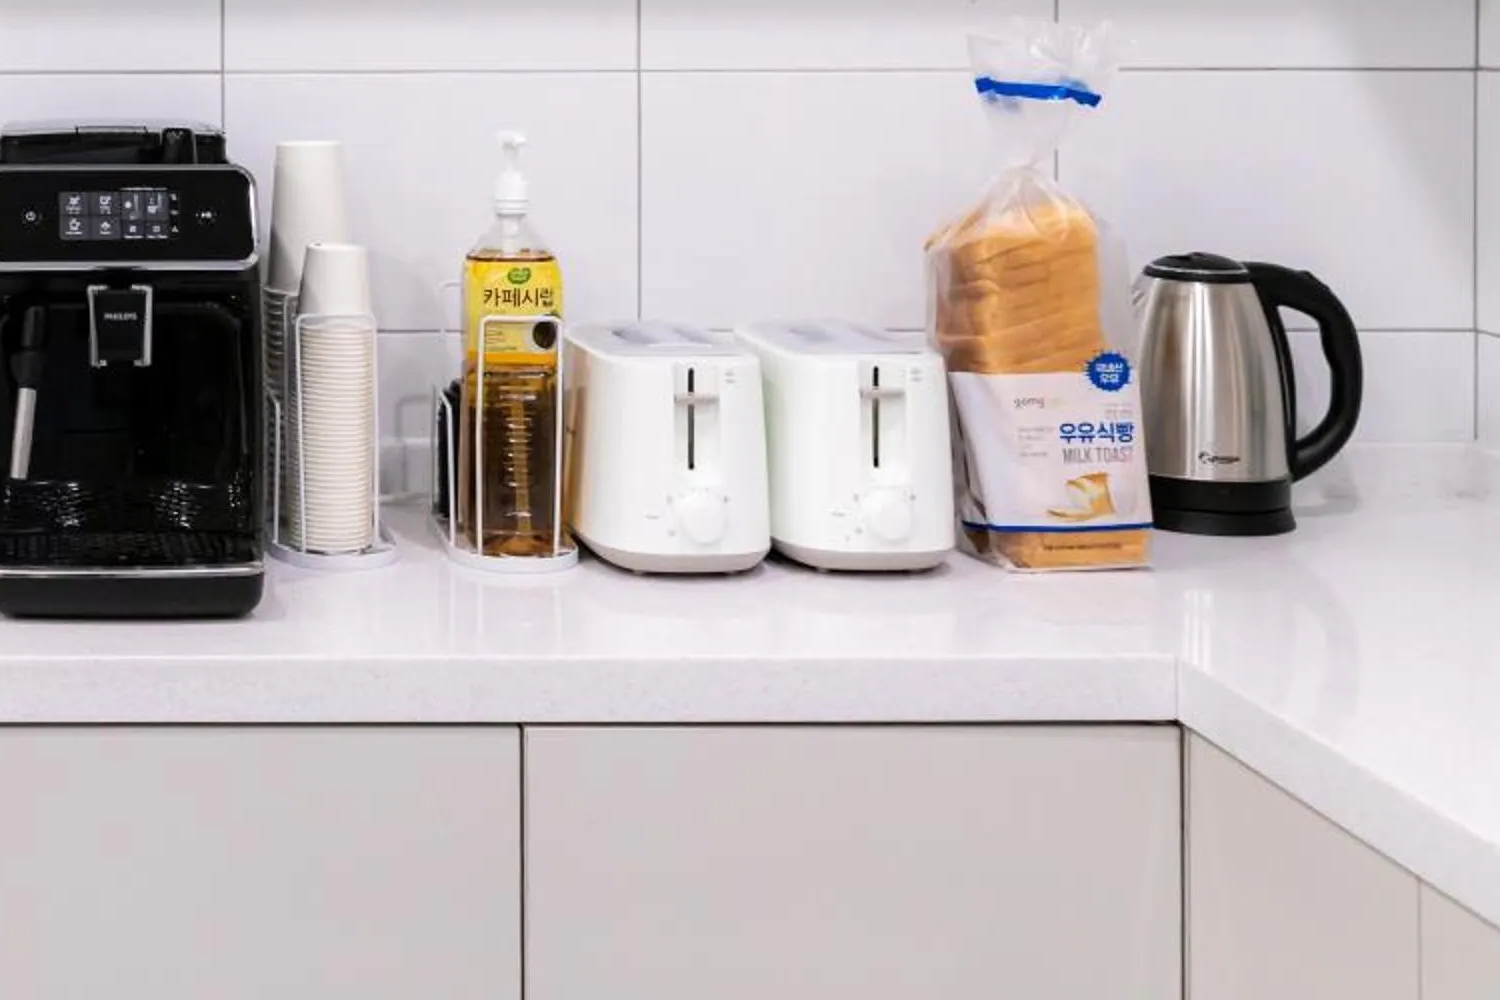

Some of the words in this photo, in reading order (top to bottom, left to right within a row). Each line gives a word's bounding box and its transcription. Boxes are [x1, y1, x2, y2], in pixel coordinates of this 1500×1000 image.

[1059, 422, 1135, 443] 우유식빵
[1062, 447, 1092, 465] MILK
[1096, 446, 1134, 464] TOAST
